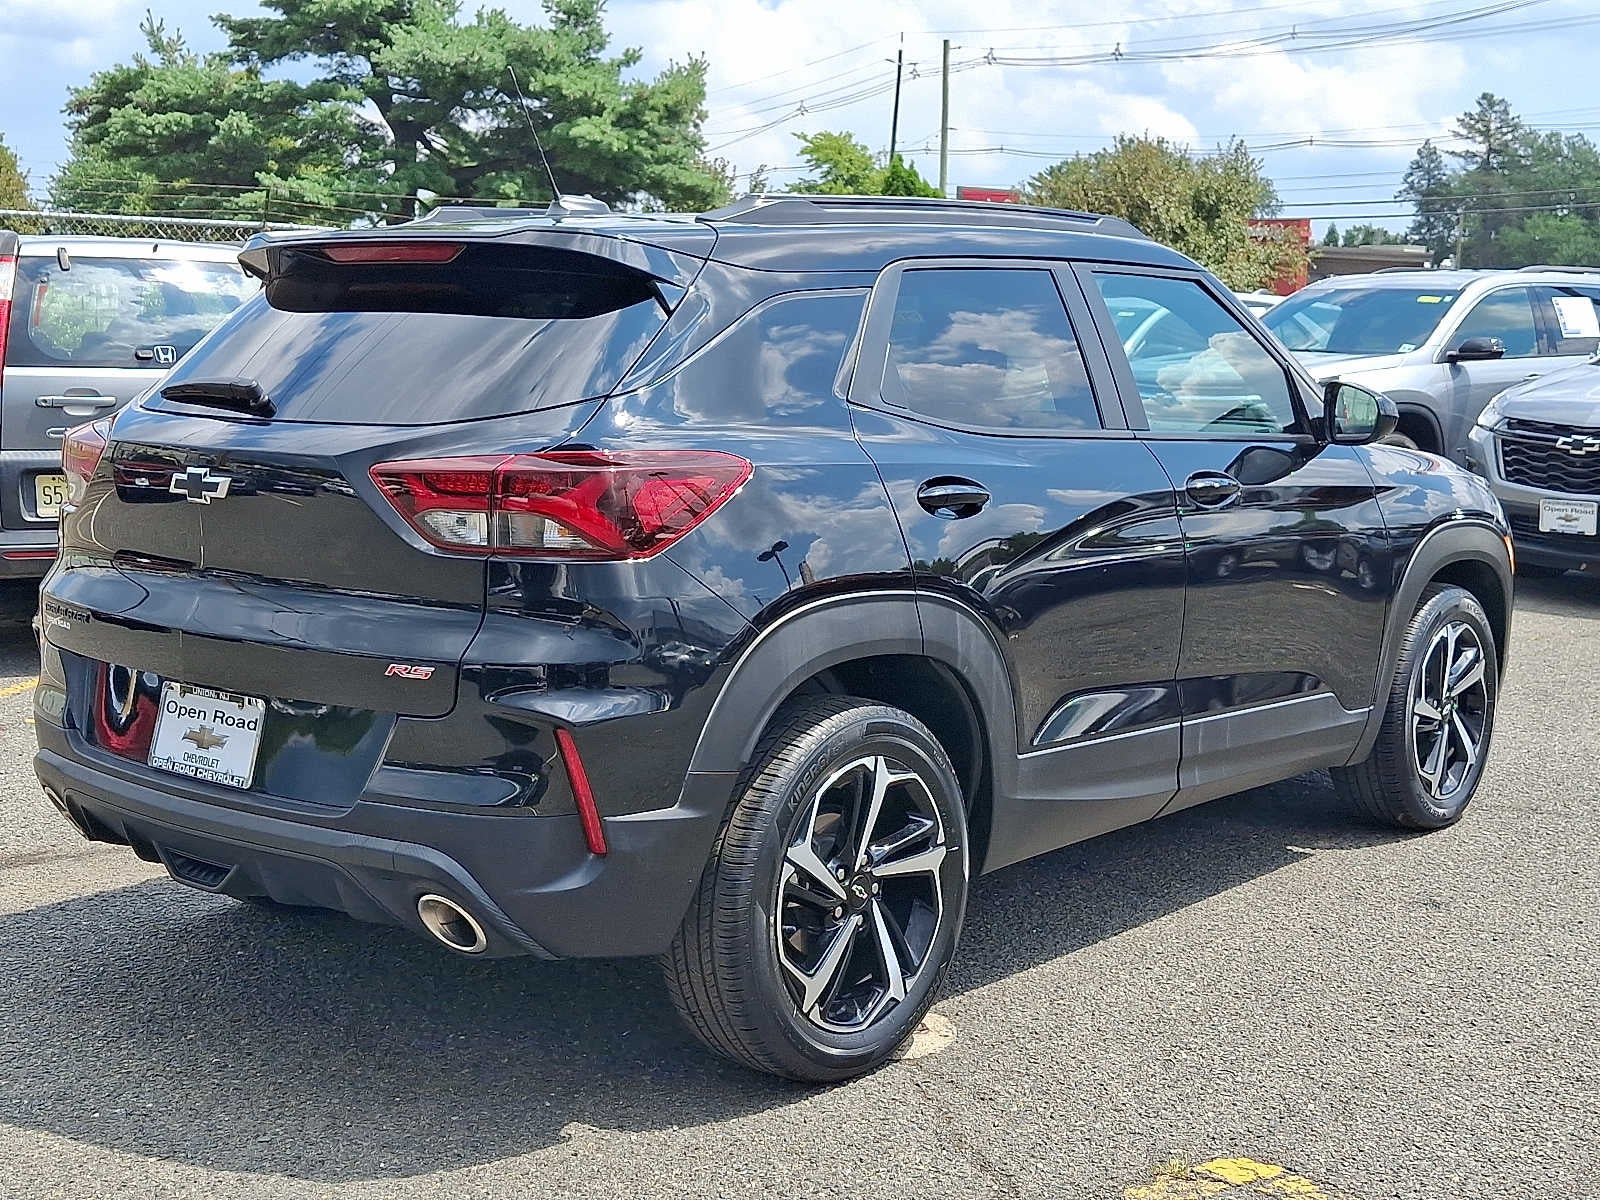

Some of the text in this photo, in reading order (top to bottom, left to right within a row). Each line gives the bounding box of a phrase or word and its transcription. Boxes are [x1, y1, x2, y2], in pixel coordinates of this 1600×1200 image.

[384, 663, 435, 680] RS
[166, 700, 258, 731] Open Road
[152, 757, 245, 787] OPEN ROAD CHEVROLET
[183, 752, 220, 769] CHEVROLET
